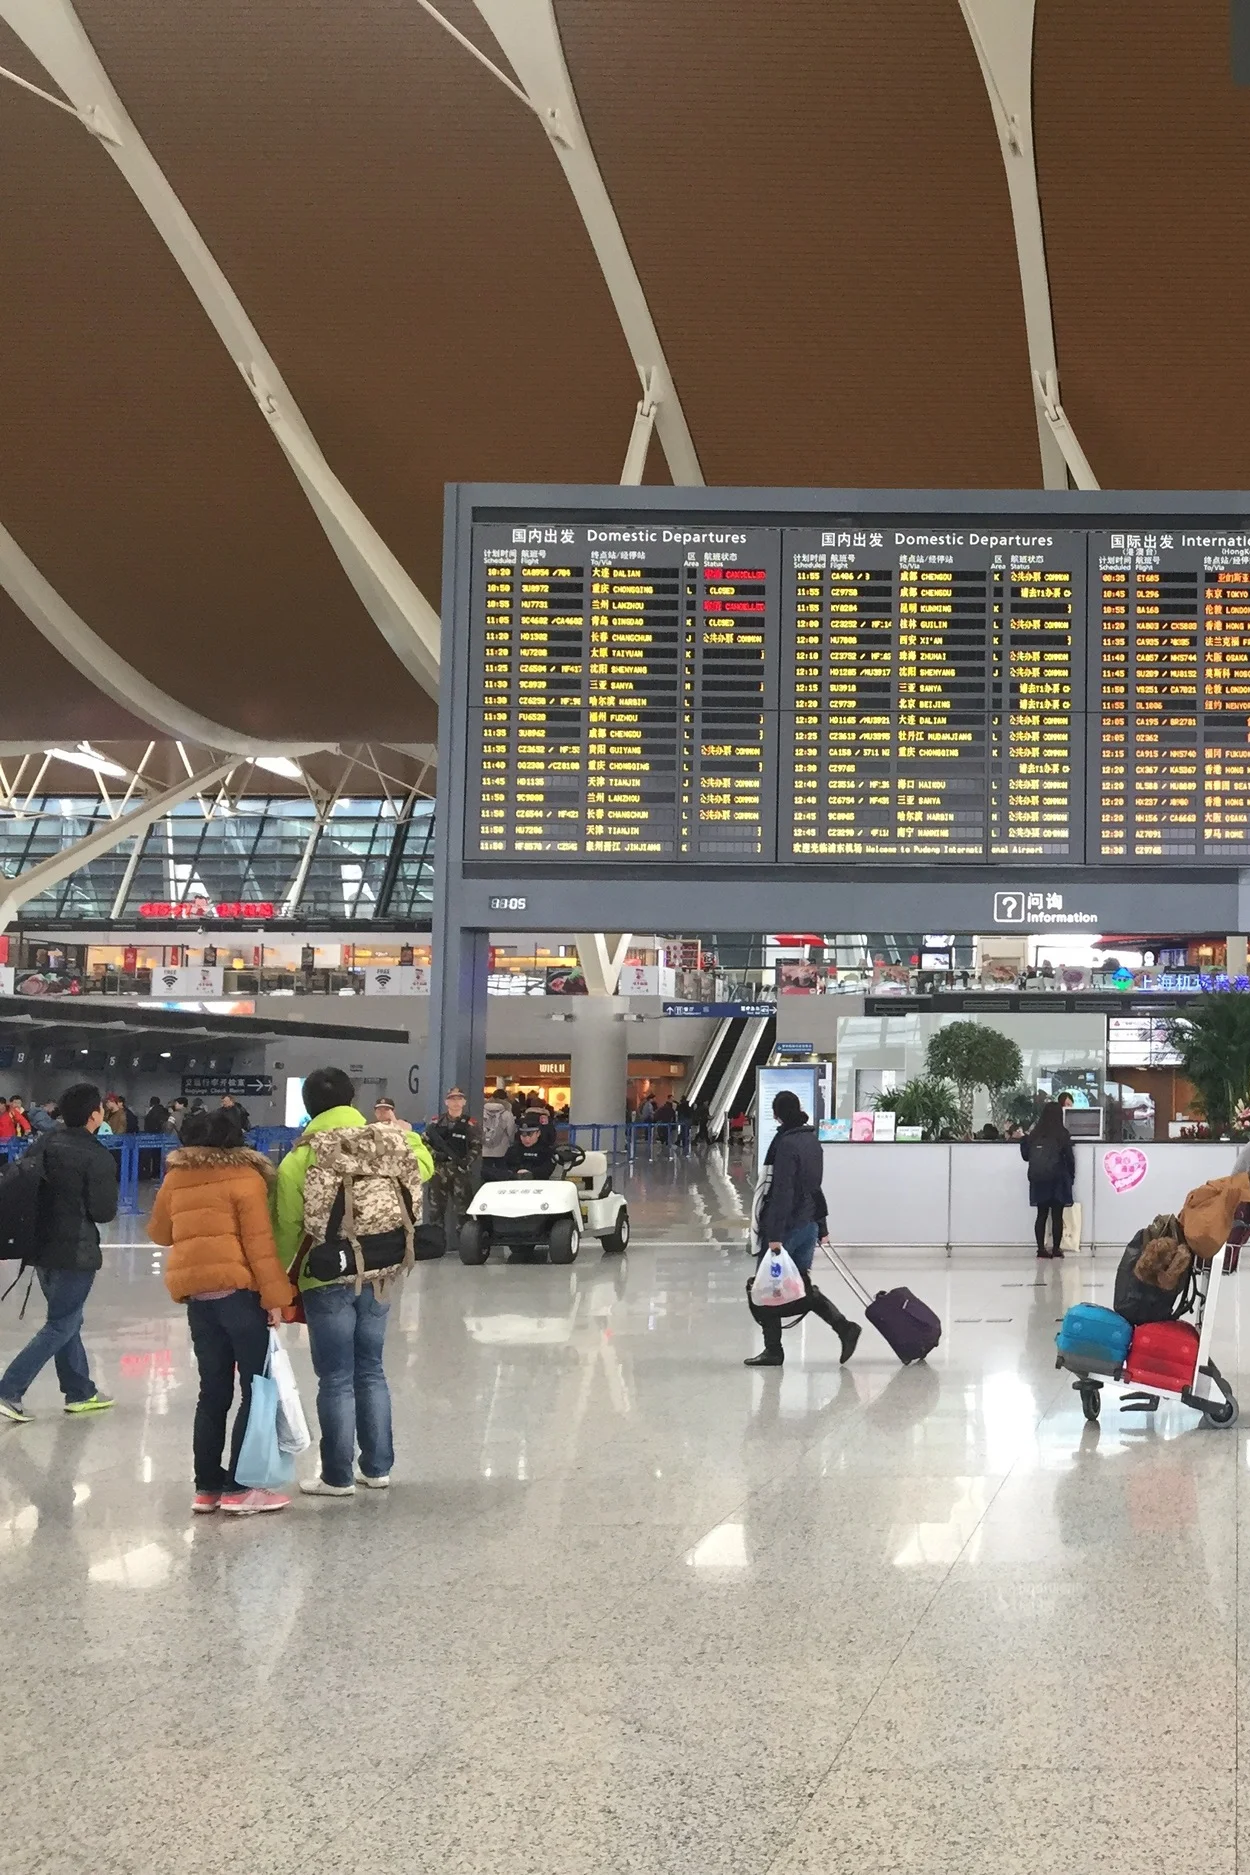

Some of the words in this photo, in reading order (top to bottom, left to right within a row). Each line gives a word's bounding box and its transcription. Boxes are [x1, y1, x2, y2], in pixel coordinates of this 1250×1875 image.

[512, 528, 575, 544] 国内出发
[587, 530, 658, 542] Domestic
[662, 530, 746, 545] Departures
[822, 532, 884, 547] 国内出发
[895, 532, 964, 545] Domestic
[970, 534, 1053, 548] Departures
[1111, 534, 1174, 549] 国际出发
[521, 550, 546, 559] 航班号
[688, 552, 696, 560] 区
[704, 552, 737, 561] 航班状态
[830, 554, 855, 563] 航班号
[994, 555, 1002, 563] 区
[1010, 554, 1044, 564] 航班状态
[1135, 556, 1160, 565] 航班号
[592, 567, 610, 578] 大连
[899, 683, 916, 692] 三亚
[1028, 892, 1062, 910] 问询
[1027, 912, 1098, 923] Information
[17, 1053, 24, 1063] 13
[408, 1064, 420, 1094] G
